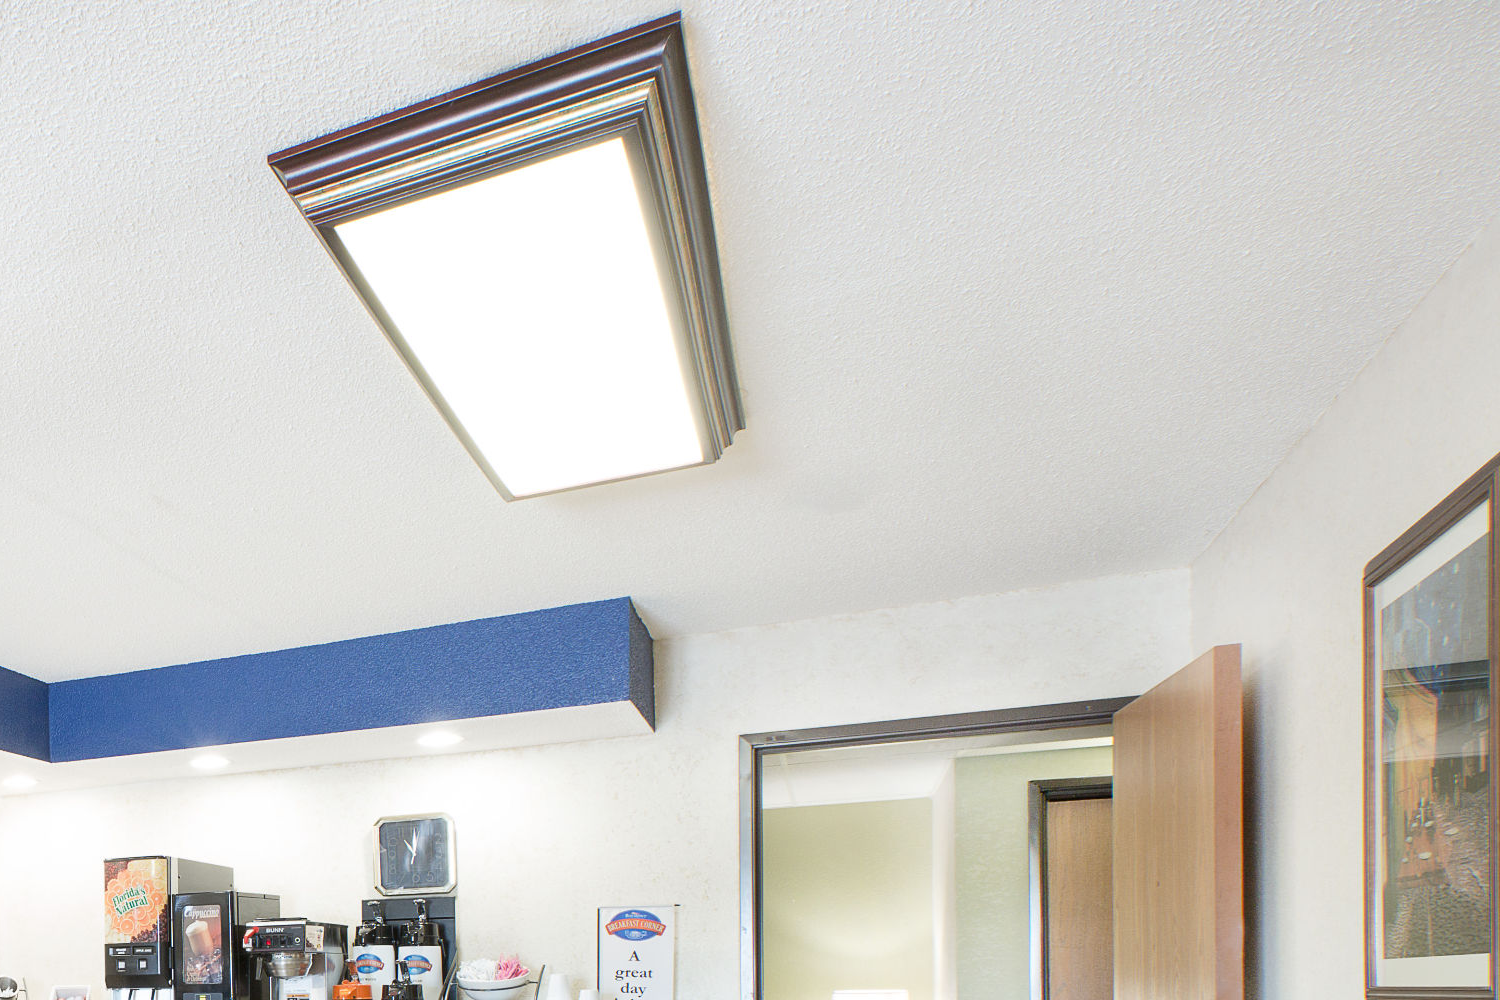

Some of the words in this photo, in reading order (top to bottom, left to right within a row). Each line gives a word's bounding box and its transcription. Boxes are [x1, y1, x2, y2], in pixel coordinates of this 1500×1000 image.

[112, 887, 147, 907] Florida's
[115, 896, 149, 916] Natural
[184, 907, 220, 919] Cappuccino
[607, 919, 639, 932] BREAKFAST
[640, 920, 665, 932] CORNER
[628, 950, 640, 961] A
[615, 969, 653, 981] great
[620, 983, 647, 997] day
